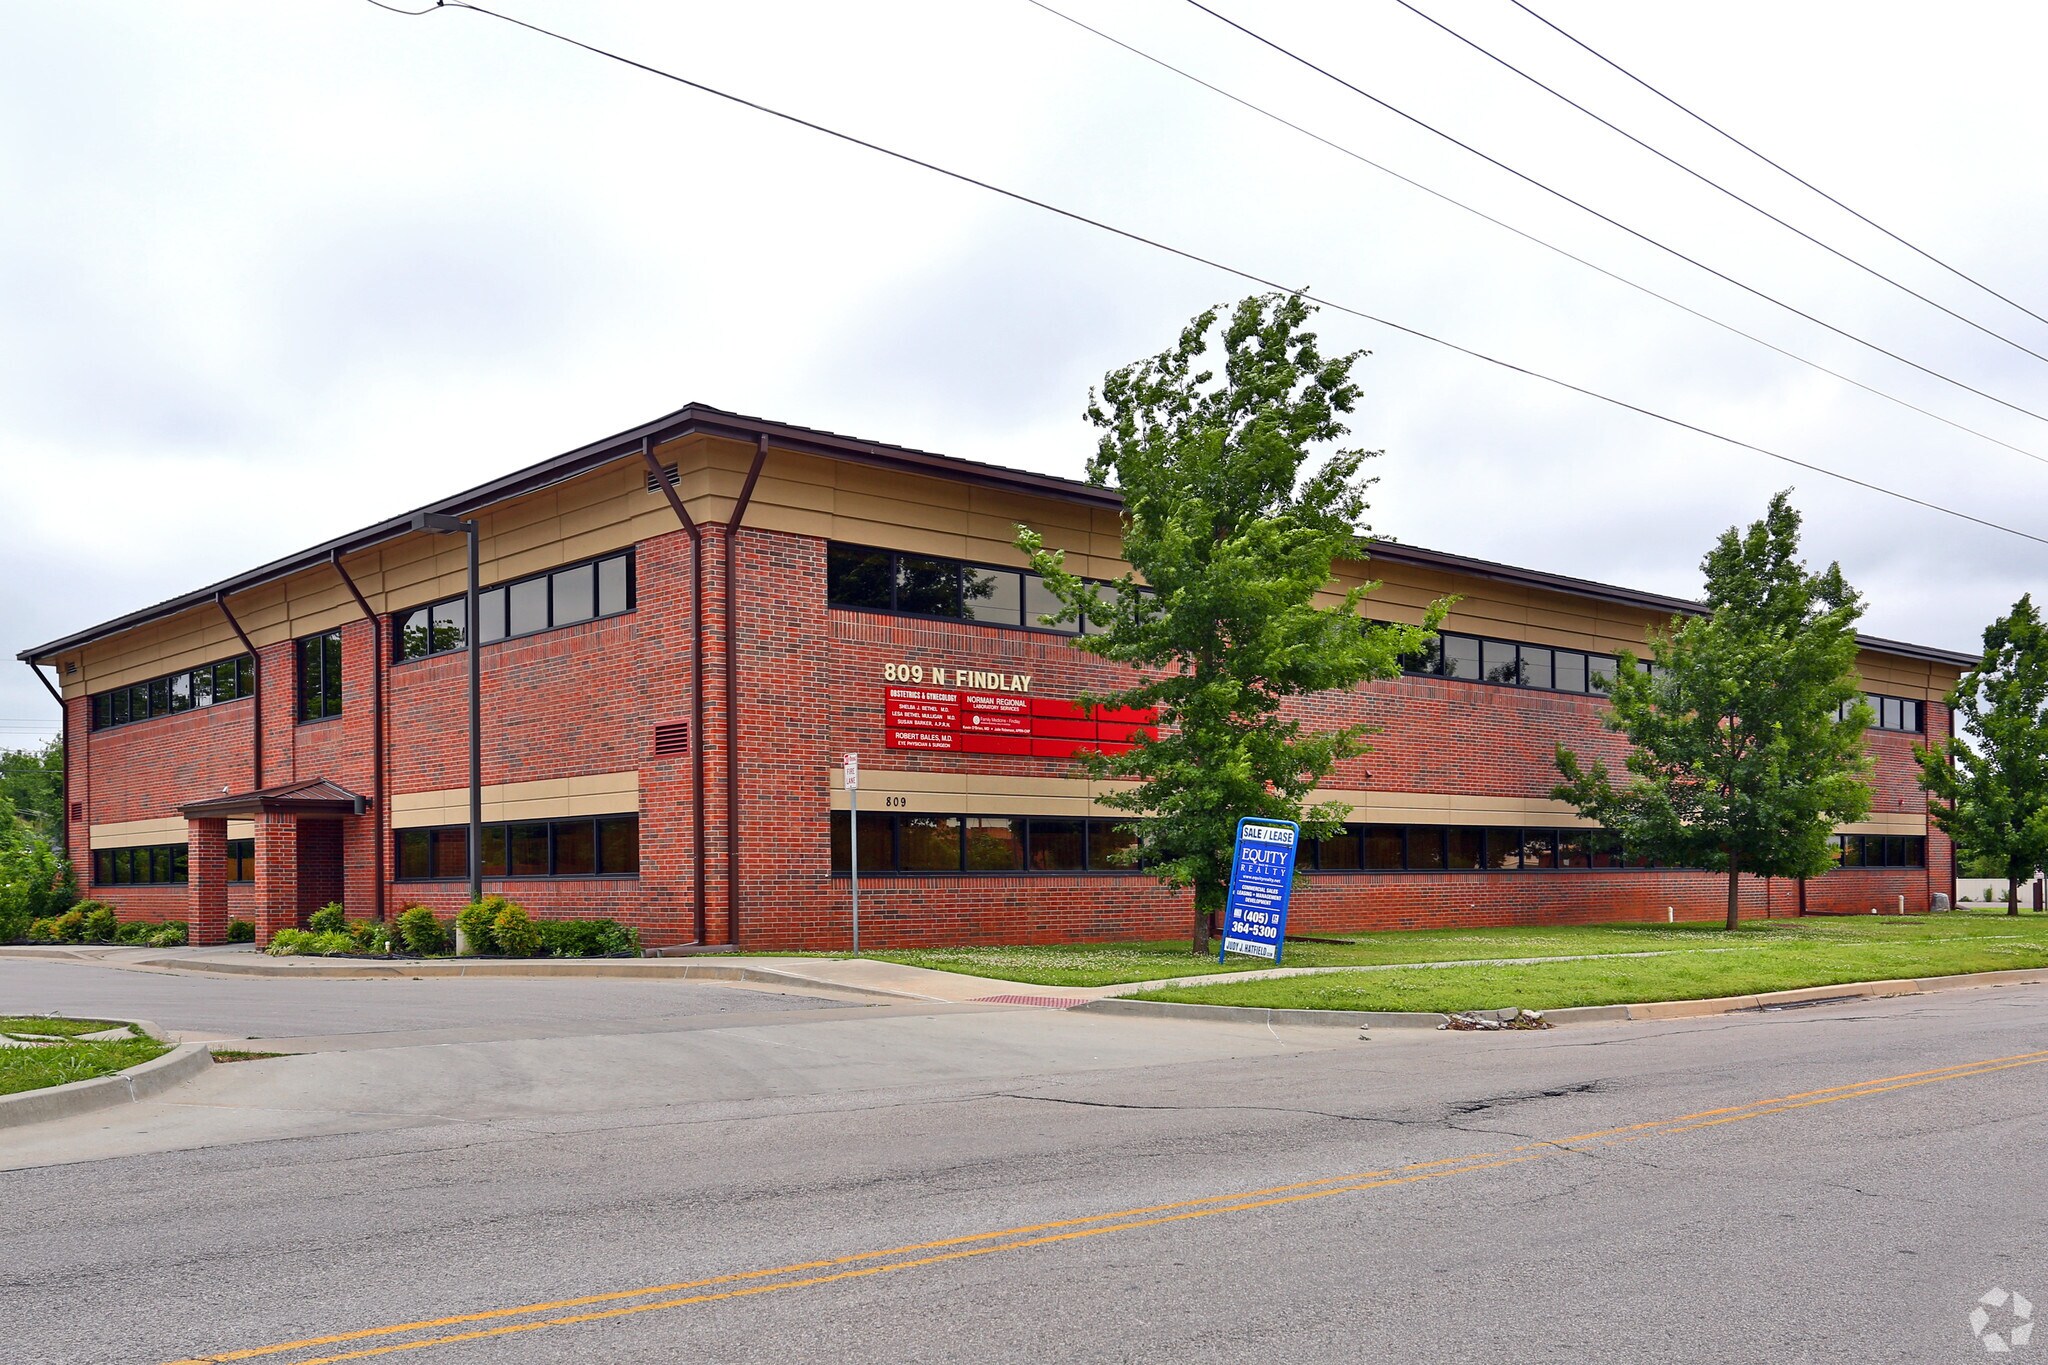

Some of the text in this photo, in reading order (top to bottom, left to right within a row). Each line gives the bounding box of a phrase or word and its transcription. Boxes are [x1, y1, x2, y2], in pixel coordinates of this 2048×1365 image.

[884, 662, 1031, 692] 809 N FINDLAY
[890, 690, 957, 702] OBSTETRICS & GYNECOLOGY
[966, 696, 1027, 707] NORMAN REGIONAL
[895, 732, 919, 740] ROBERT
[920, 734, 940, 742] BALES,
[886, 796, 906, 807] 809
[1244, 827, 1262, 839] SALE
[1269, 830, 1293, 843] LEASE
[1242, 848, 1288, 865] EQUITY
[1240, 864, 1286, 877] REALTY
[1243, 875, 1281, 883] www.equityrealty.net
[1245, 897, 1272, 906] DEVELOPMENT
[1256, 892, 1282, 901] MANAGEMENT
[1243, 910, 1268, 925] (405)
[1232, 921, 1277, 938] 364-5300
[1226, 941, 1239, 950] JUDY
[1239, 944, 1244, 952] J.
[1245, 944, 1267, 956] HATFIELD
